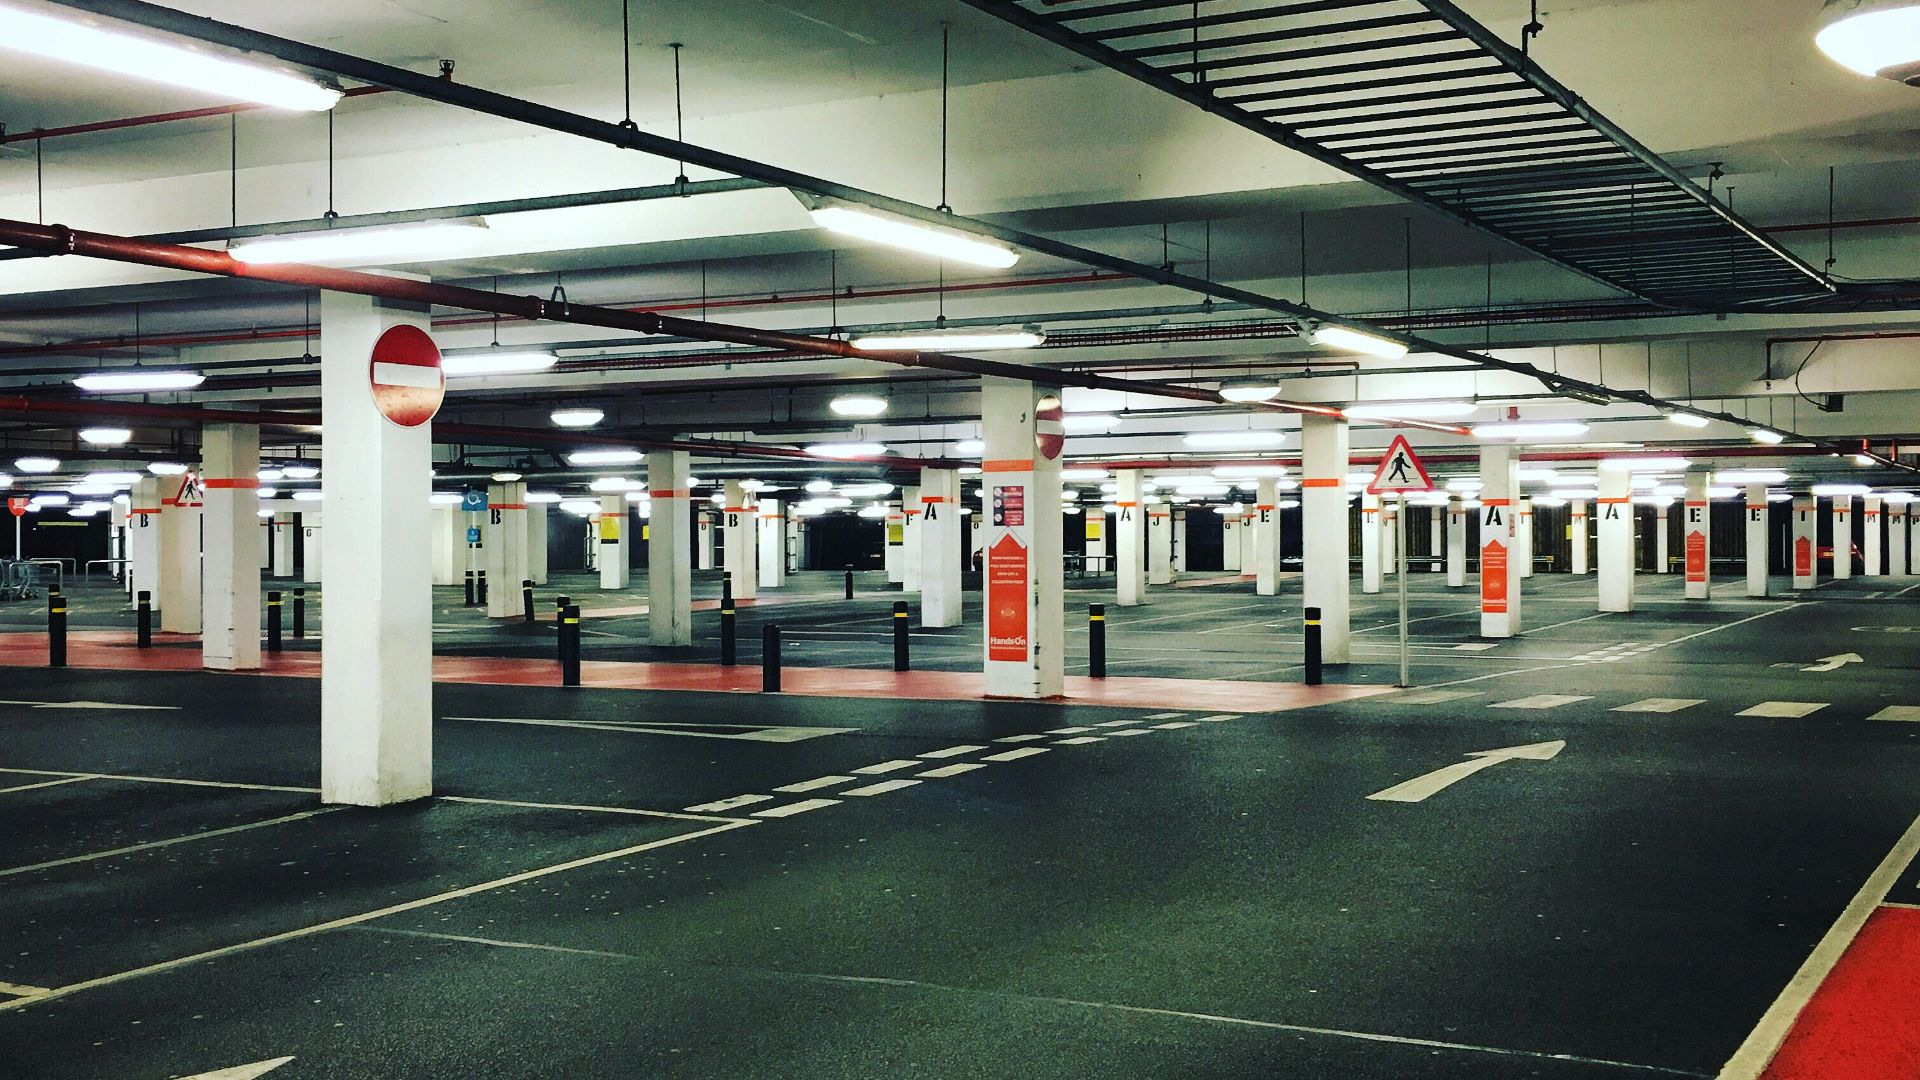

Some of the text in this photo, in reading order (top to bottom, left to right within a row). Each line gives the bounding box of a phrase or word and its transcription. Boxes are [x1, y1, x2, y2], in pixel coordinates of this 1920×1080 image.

[490, 508, 502, 525] B
[924, 502, 937, 520] A
[1120, 506, 1131, 521] A
[1260, 508, 1270, 523] E
[1485, 505, 1503, 526] A
[1605, 503, 1619, 520] A
[1690, 507, 1701, 523] E
[1750, 508, 1761, 522] E
[140, 513, 149, 528] B
[728, 513, 738, 528] B
